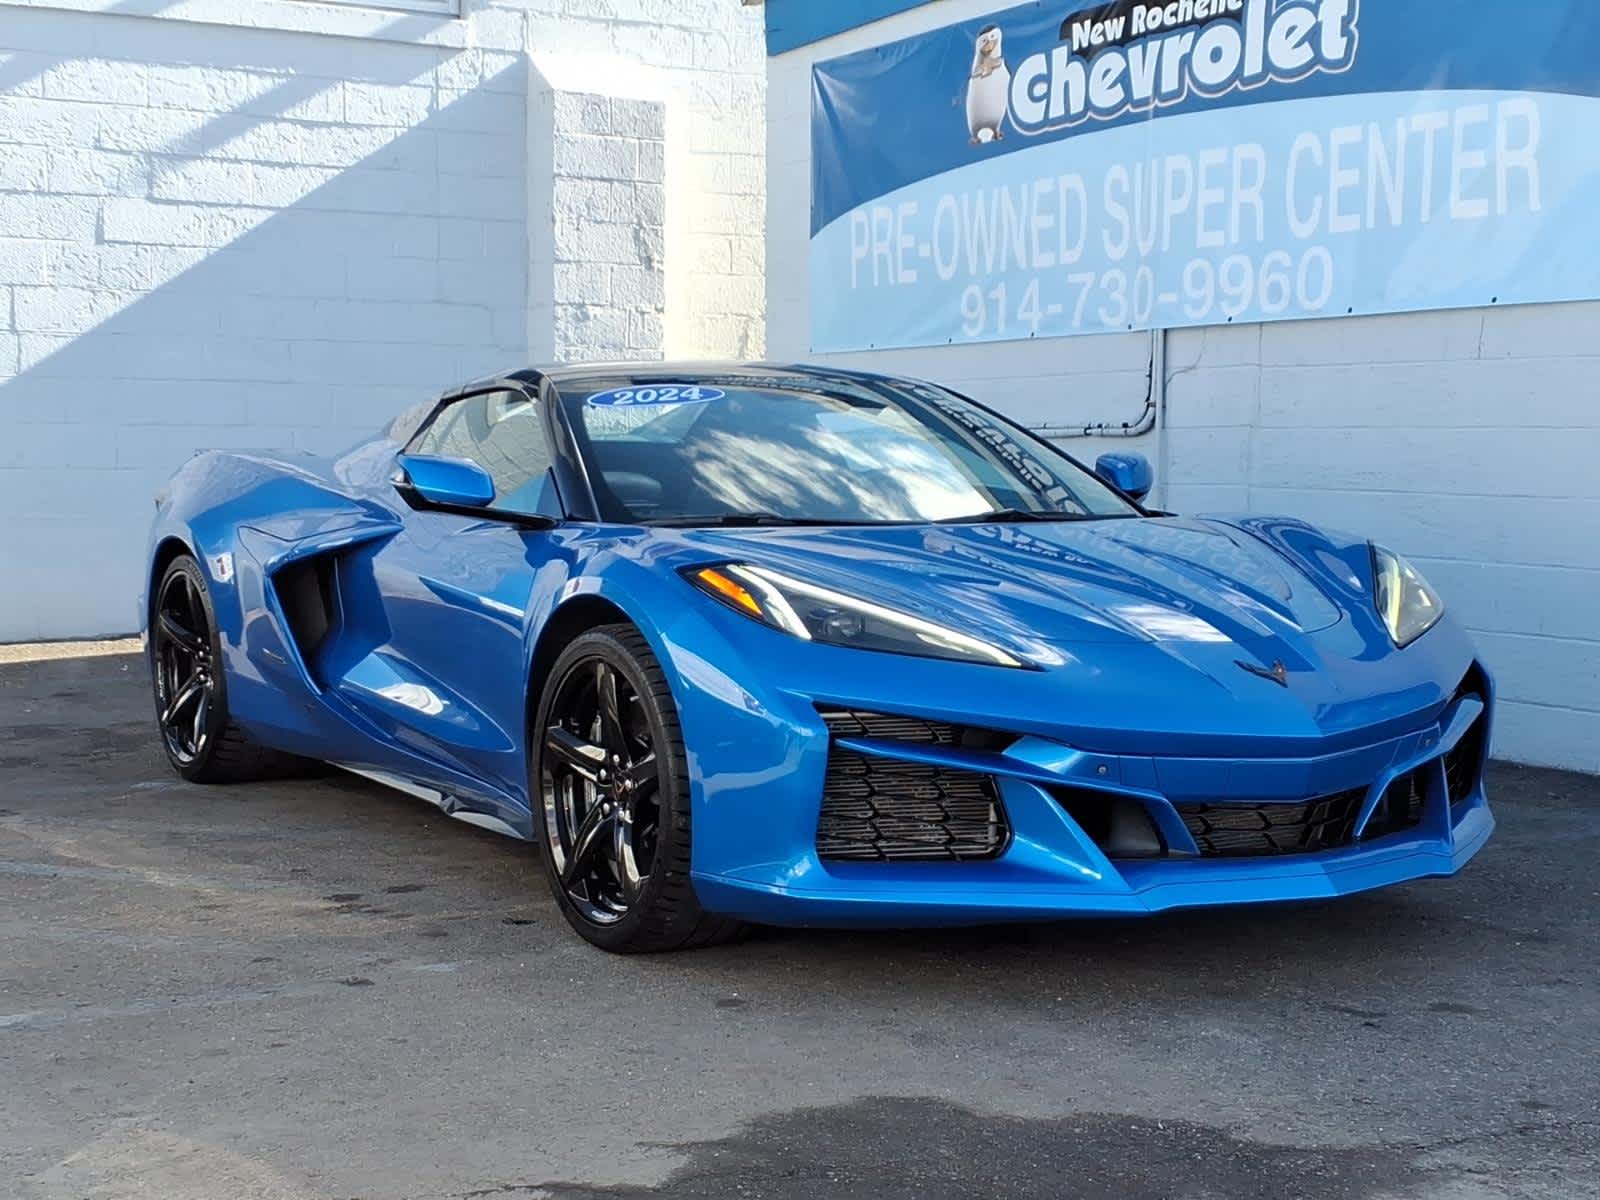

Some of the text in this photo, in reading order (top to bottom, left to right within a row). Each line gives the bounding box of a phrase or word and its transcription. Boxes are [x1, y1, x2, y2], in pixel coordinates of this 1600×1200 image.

[1012, 0, 1349, 124] Chevrolet
[1072, 16, 1125, 50] New
[849, 97, 1541, 288] PRE-OWNED SUPER CENTER
[960, 246, 1334, 337] 914-730-9960
[612, 387, 704, 405] 2024
